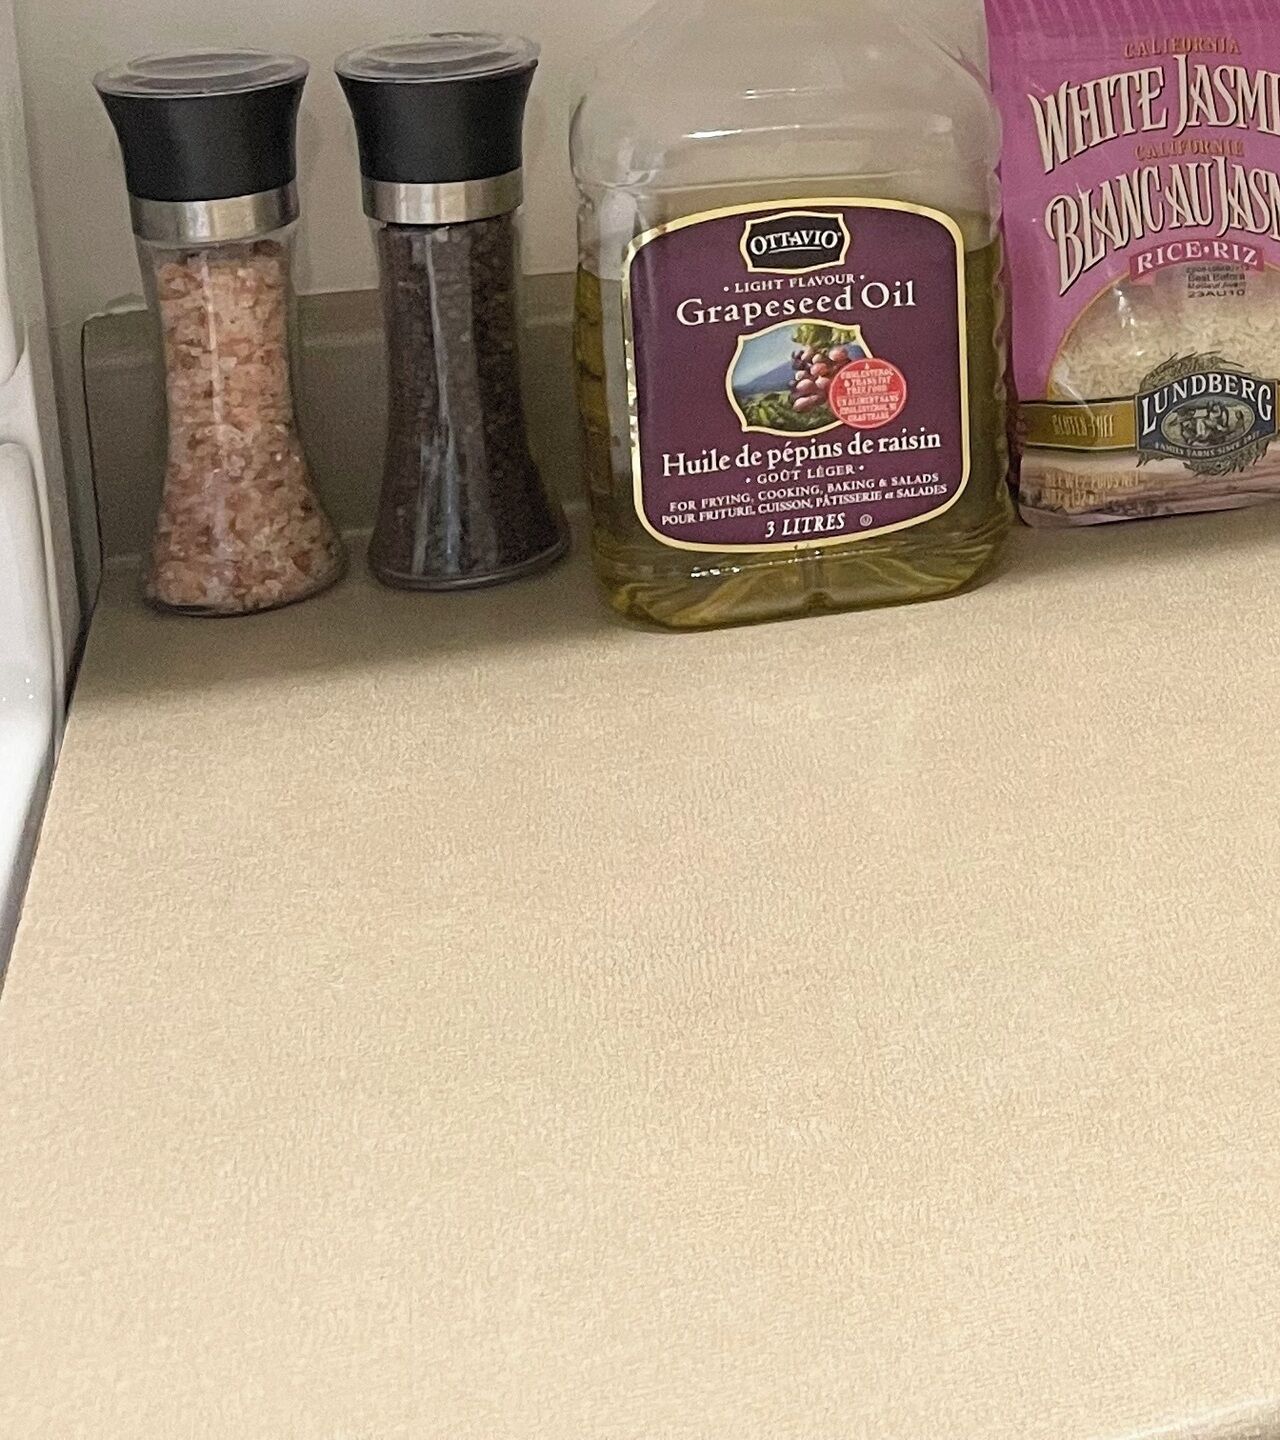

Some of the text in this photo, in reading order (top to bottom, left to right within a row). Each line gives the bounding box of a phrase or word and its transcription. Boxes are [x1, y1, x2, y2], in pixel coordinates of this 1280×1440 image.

[1124, 36, 1242, 58] CALIFORNIA
[1027, 65, 1168, 174] WHITE
[1133, 139, 1245, 160] CALIFORNIE
[750, 229, 838, 255] OTTAVIO
[1044, 164, 1163, 297] BLANC
[1165, 161, 1213, 229] AU
[1137, 241, 1258, 274] RICE RIZ
[734, 273, 855, 293] LIGHT FLAVOUR
[676, 280, 917, 327] Grapeseed Oil
[1142, 373, 1272, 436] LUNDBERG
[662, 426, 942, 477] Huile de pépins de raisin
[1187, 448, 1215, 457] FARMS
[757, 464, 856, 484] GOÛT LÉGER
[661, 513, 697, 526] POUR
[816, 490, 882, 508] PÂTISSERIE
[897, 483, 948, 499] SALADES
[670, 472, 939, 512] FOR FRYING, COOKING, BAKING & SALADS
[765, 512, 846, 538] 3 LITRES
